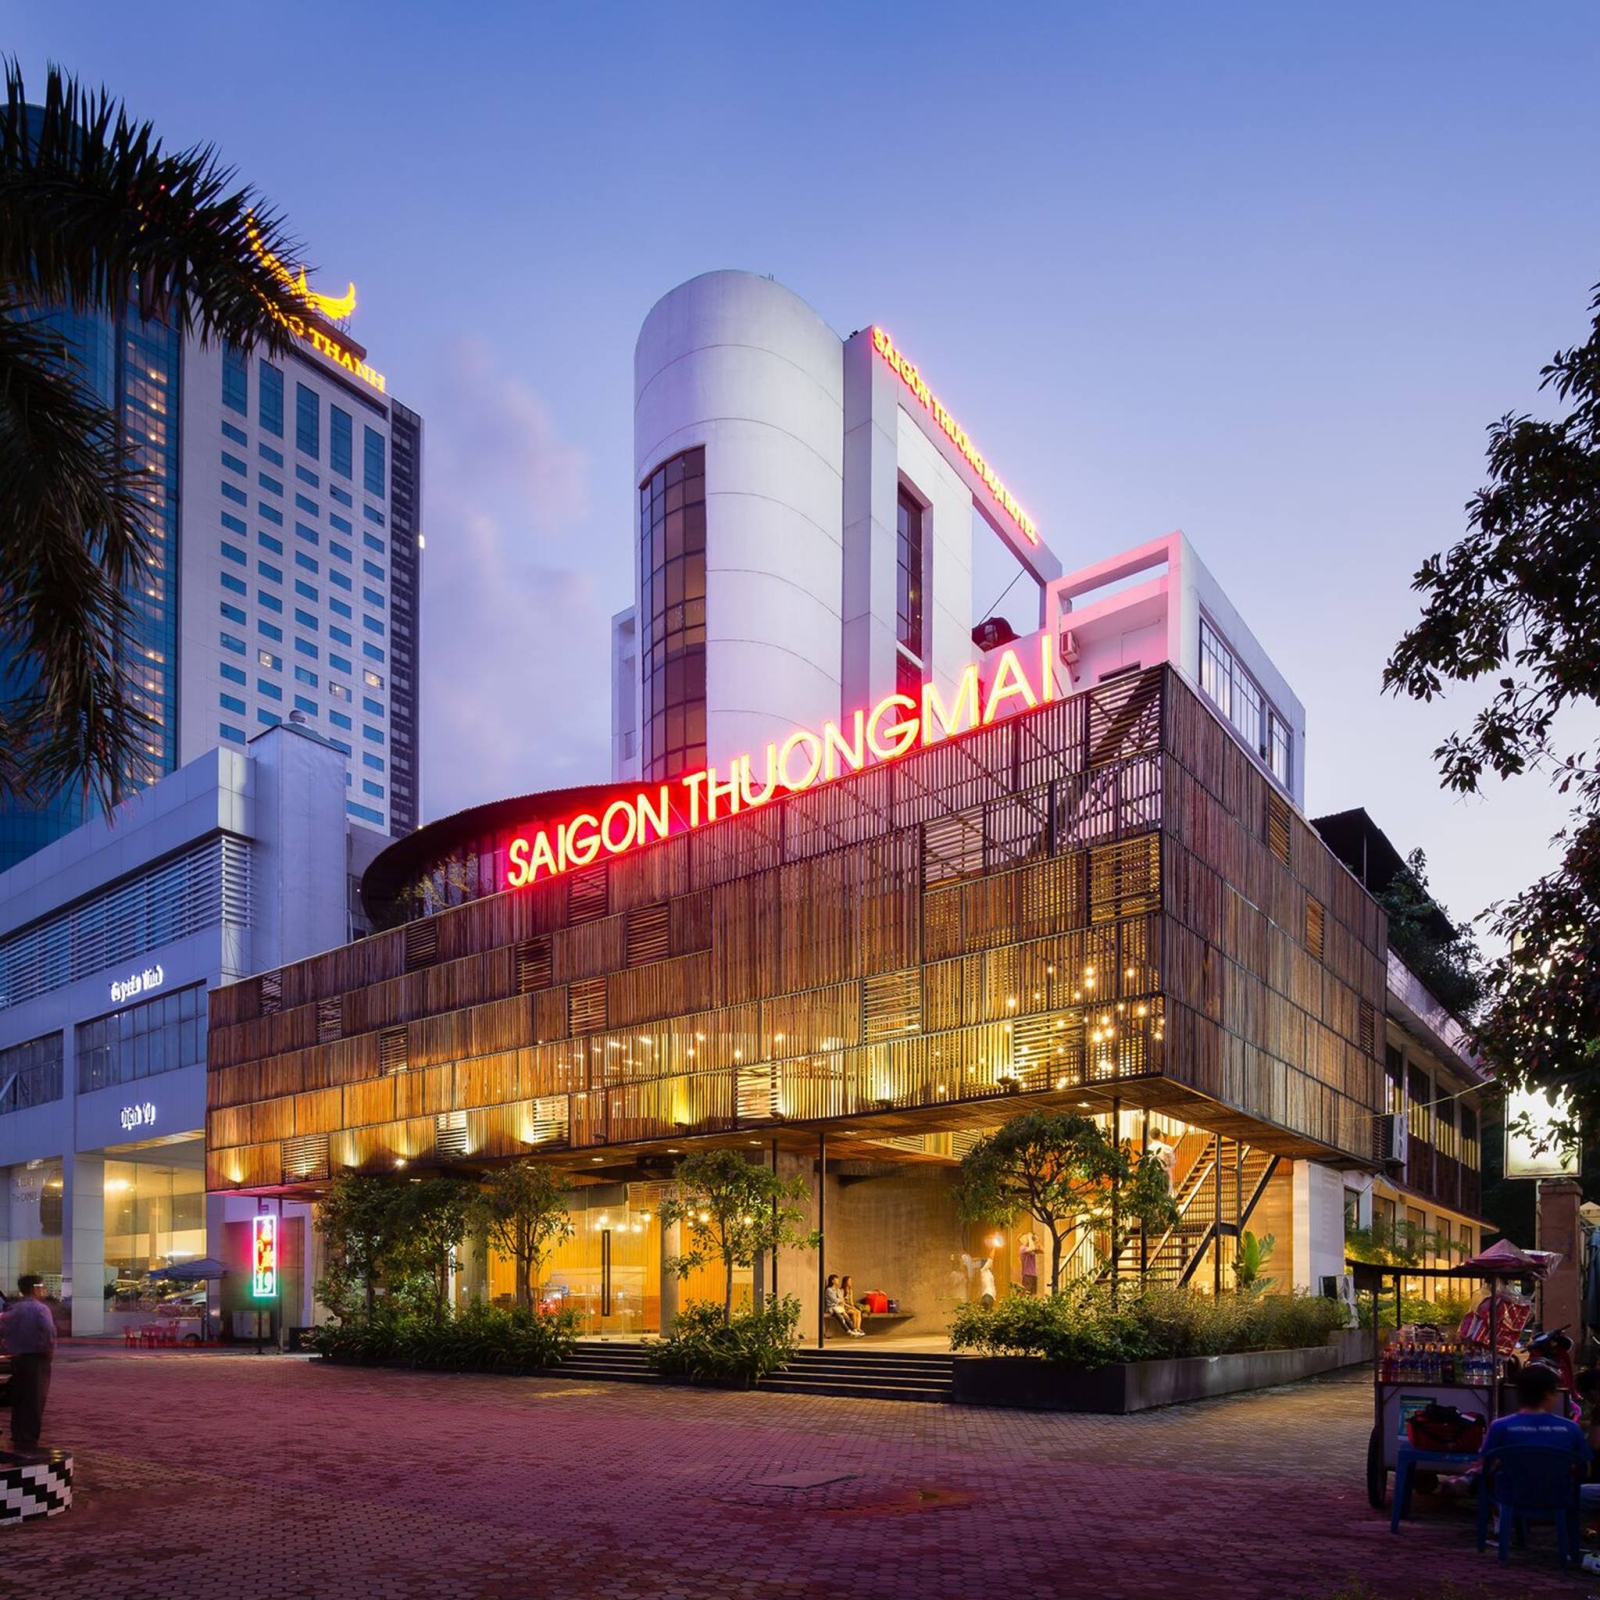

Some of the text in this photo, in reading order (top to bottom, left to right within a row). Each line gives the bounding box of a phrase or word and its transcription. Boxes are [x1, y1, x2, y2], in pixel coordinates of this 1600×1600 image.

[309, 326, 386, 394] THANH
[507, 634, 1053, 887] SAIGON THUONGMAI
